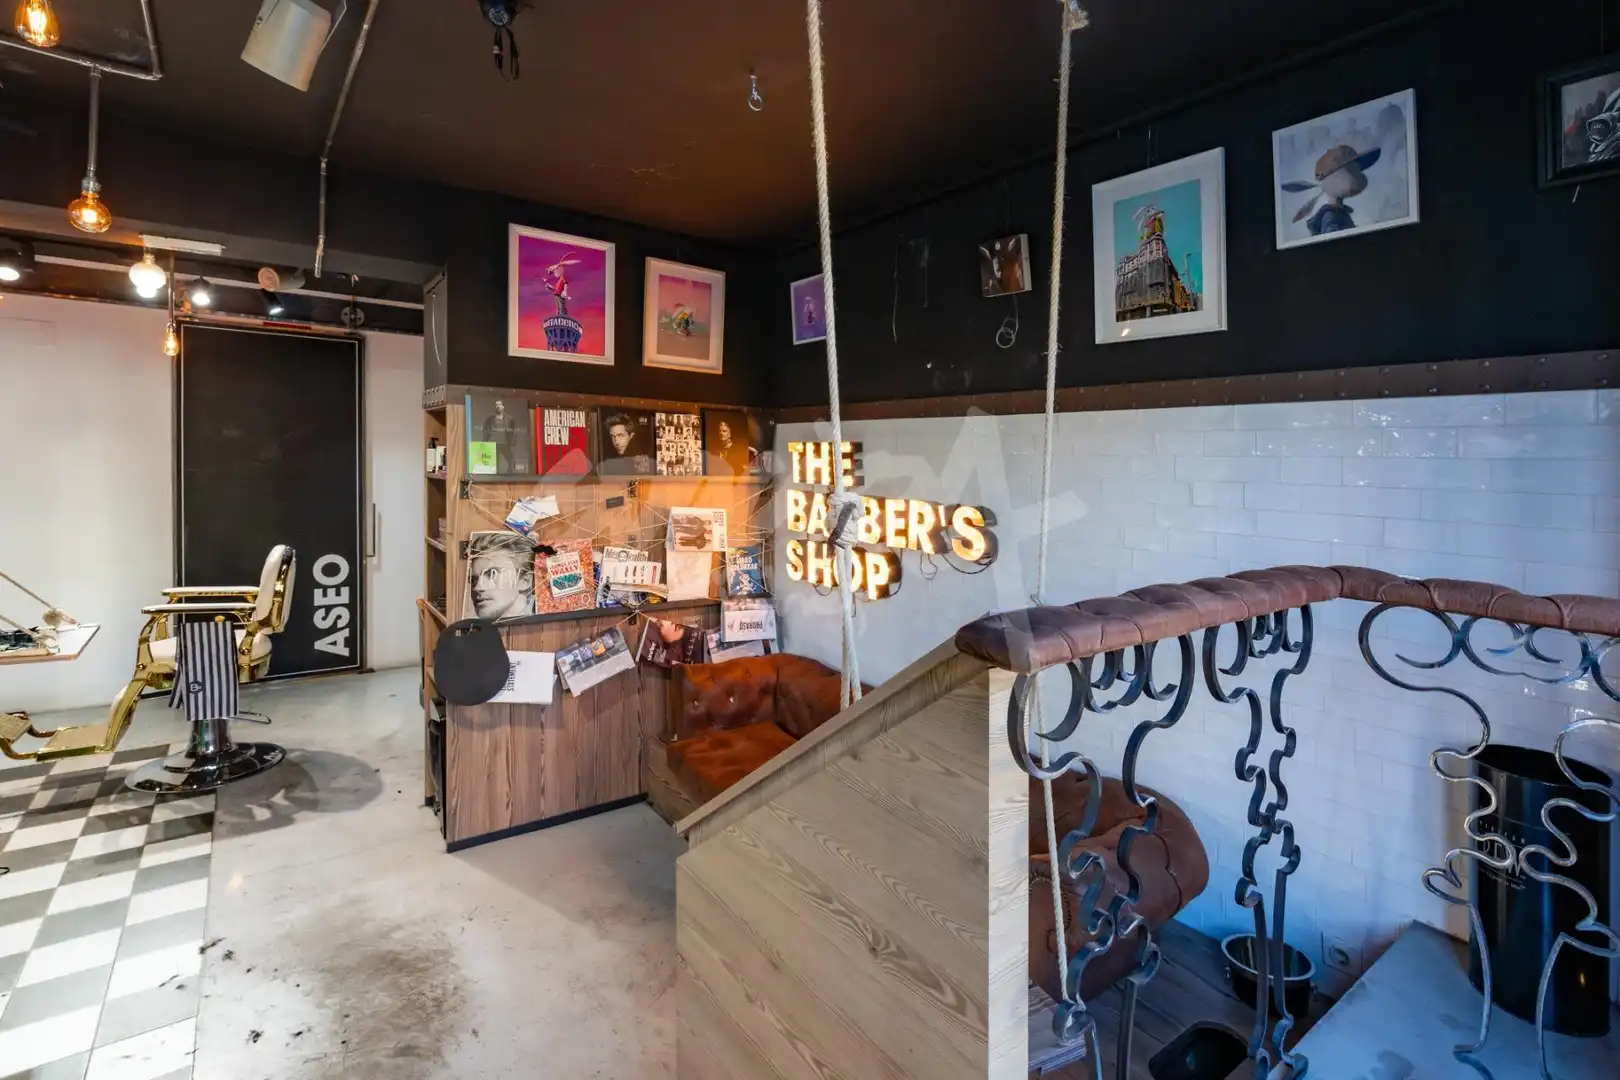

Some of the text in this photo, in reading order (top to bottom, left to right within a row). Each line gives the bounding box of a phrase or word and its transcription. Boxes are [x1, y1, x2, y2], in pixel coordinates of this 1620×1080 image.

[544, 409, 586, 428] AMERICAN
[544, 426, 569, 445] CREW
[788, 442, 856, 486] THE
[787, 489, 988, 561] BABER'S
[481, 567, 522, 589] CREW
[551, 564, 579, 576] WALLY
[313, 553, 350, 657] ASEO
[508, 662, 516, 692] STATEMENT
